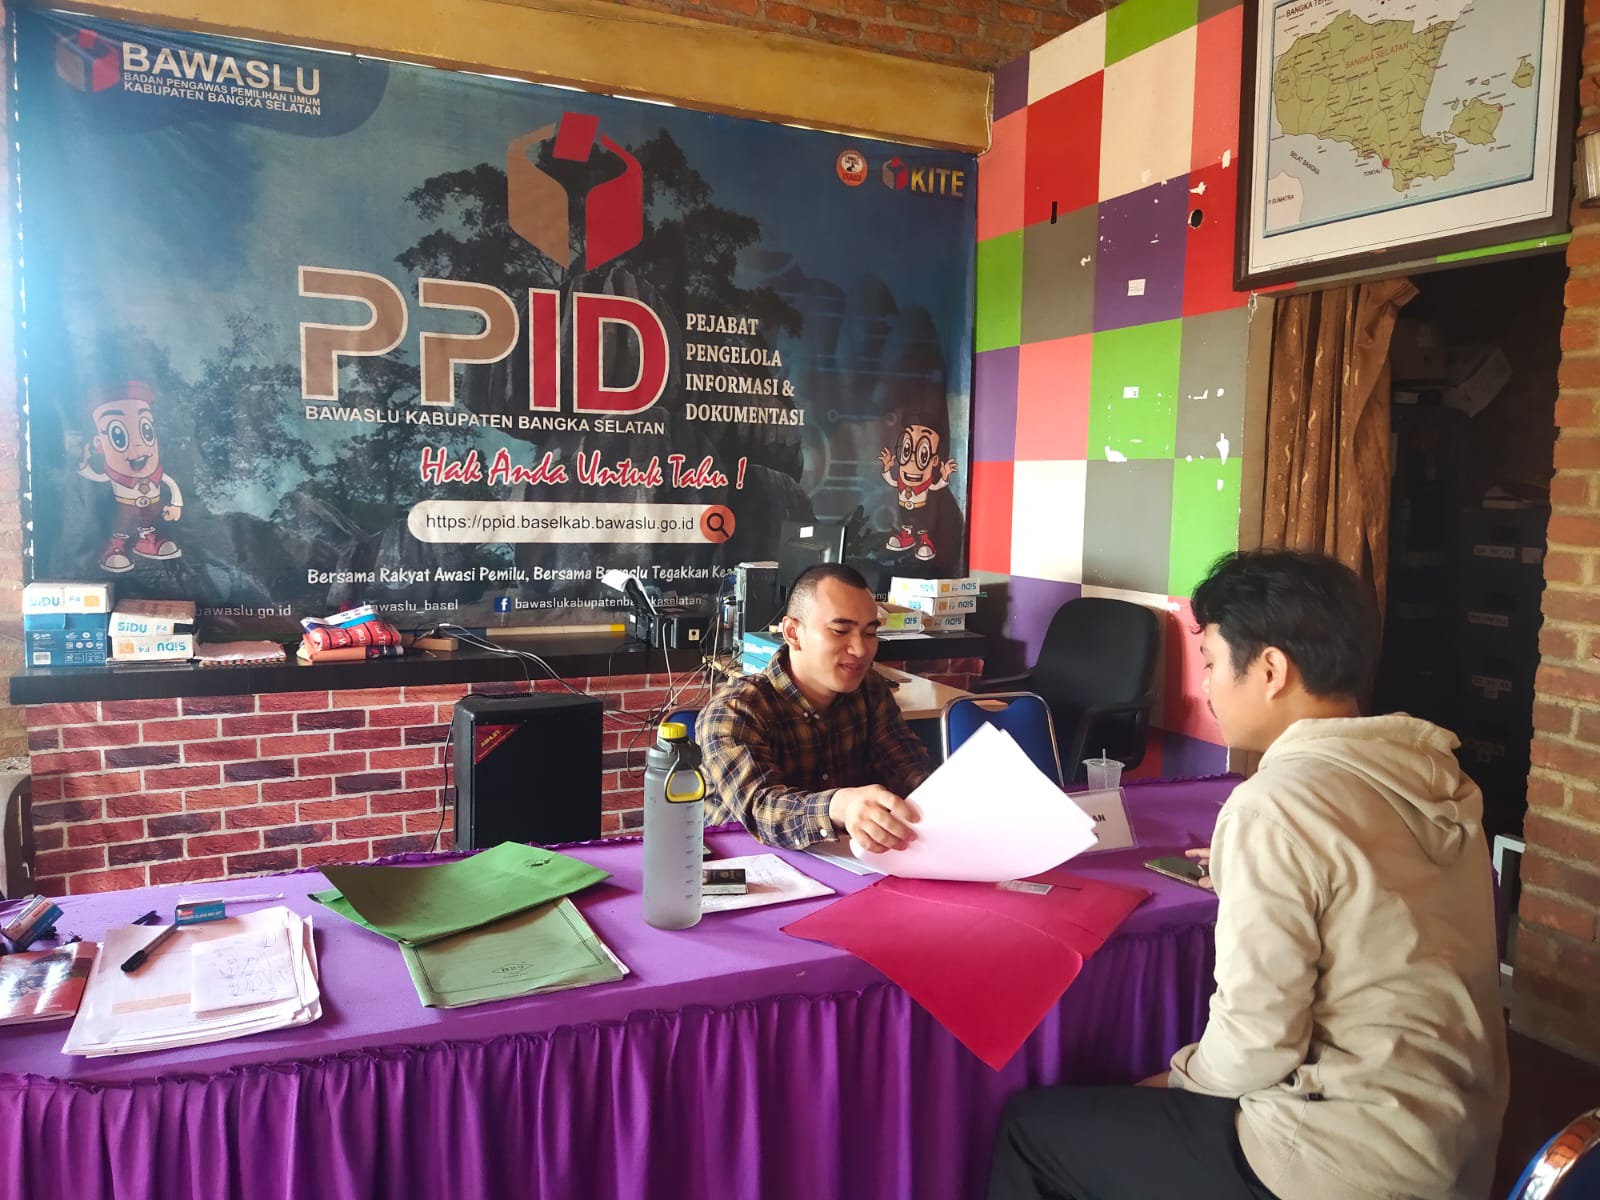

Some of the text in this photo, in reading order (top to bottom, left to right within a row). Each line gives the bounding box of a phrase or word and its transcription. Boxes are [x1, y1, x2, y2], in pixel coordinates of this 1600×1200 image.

[1286, 1, 1312, 17] BANGKA
[122, 41, 320, 96] BAWASLU
[124, 72, 320, 106] BADAN PENGAWAS PEMILIHAN UMUM
[124, 81, 320, 116] KABUPATEN BANGKA SELATAN
[911, 168, 965, 198] KITE
[685, 313, 759, 335] PEJABAT
[298, 265, 670, 415] PPID
[685, 343, 783, 367] PENGELOLA
[685, 373, 796, 397] INFORMASI &
[305, 404, 665, 435] BAWASLU KABUPATEN BANGKA SELATAN
[685, 403, 805, 426] DOKUMENTASI
[419, 446, 748, 490] Hak Anda Untuk Tahu !
[425, 513, 695, 532] https://ppid.baselkab.bawaslu.go.id
[307, 568, 376, 584] Bersama
[379, 567, 430, 585] Rakyat
[434, 567, 476, 582] Awasi
[479, 566, 530, 583] Pemilu,
[533, 566, 592, 581] Bersama
[595, 565, 648, 579] Baslu
[651, 565, 709, 582] Tegakkan
[197, 604, 292, 619] awaslu.go.id
[363, 598, 459, 614] waslu_basel
[515, 596, 702, 610] bawaslukabupatenbkaselatan
[117, 621, 148, 633] SiDU
[904, 617, 917, 625] SiD
[157, 641, 187, 652] SiDU
